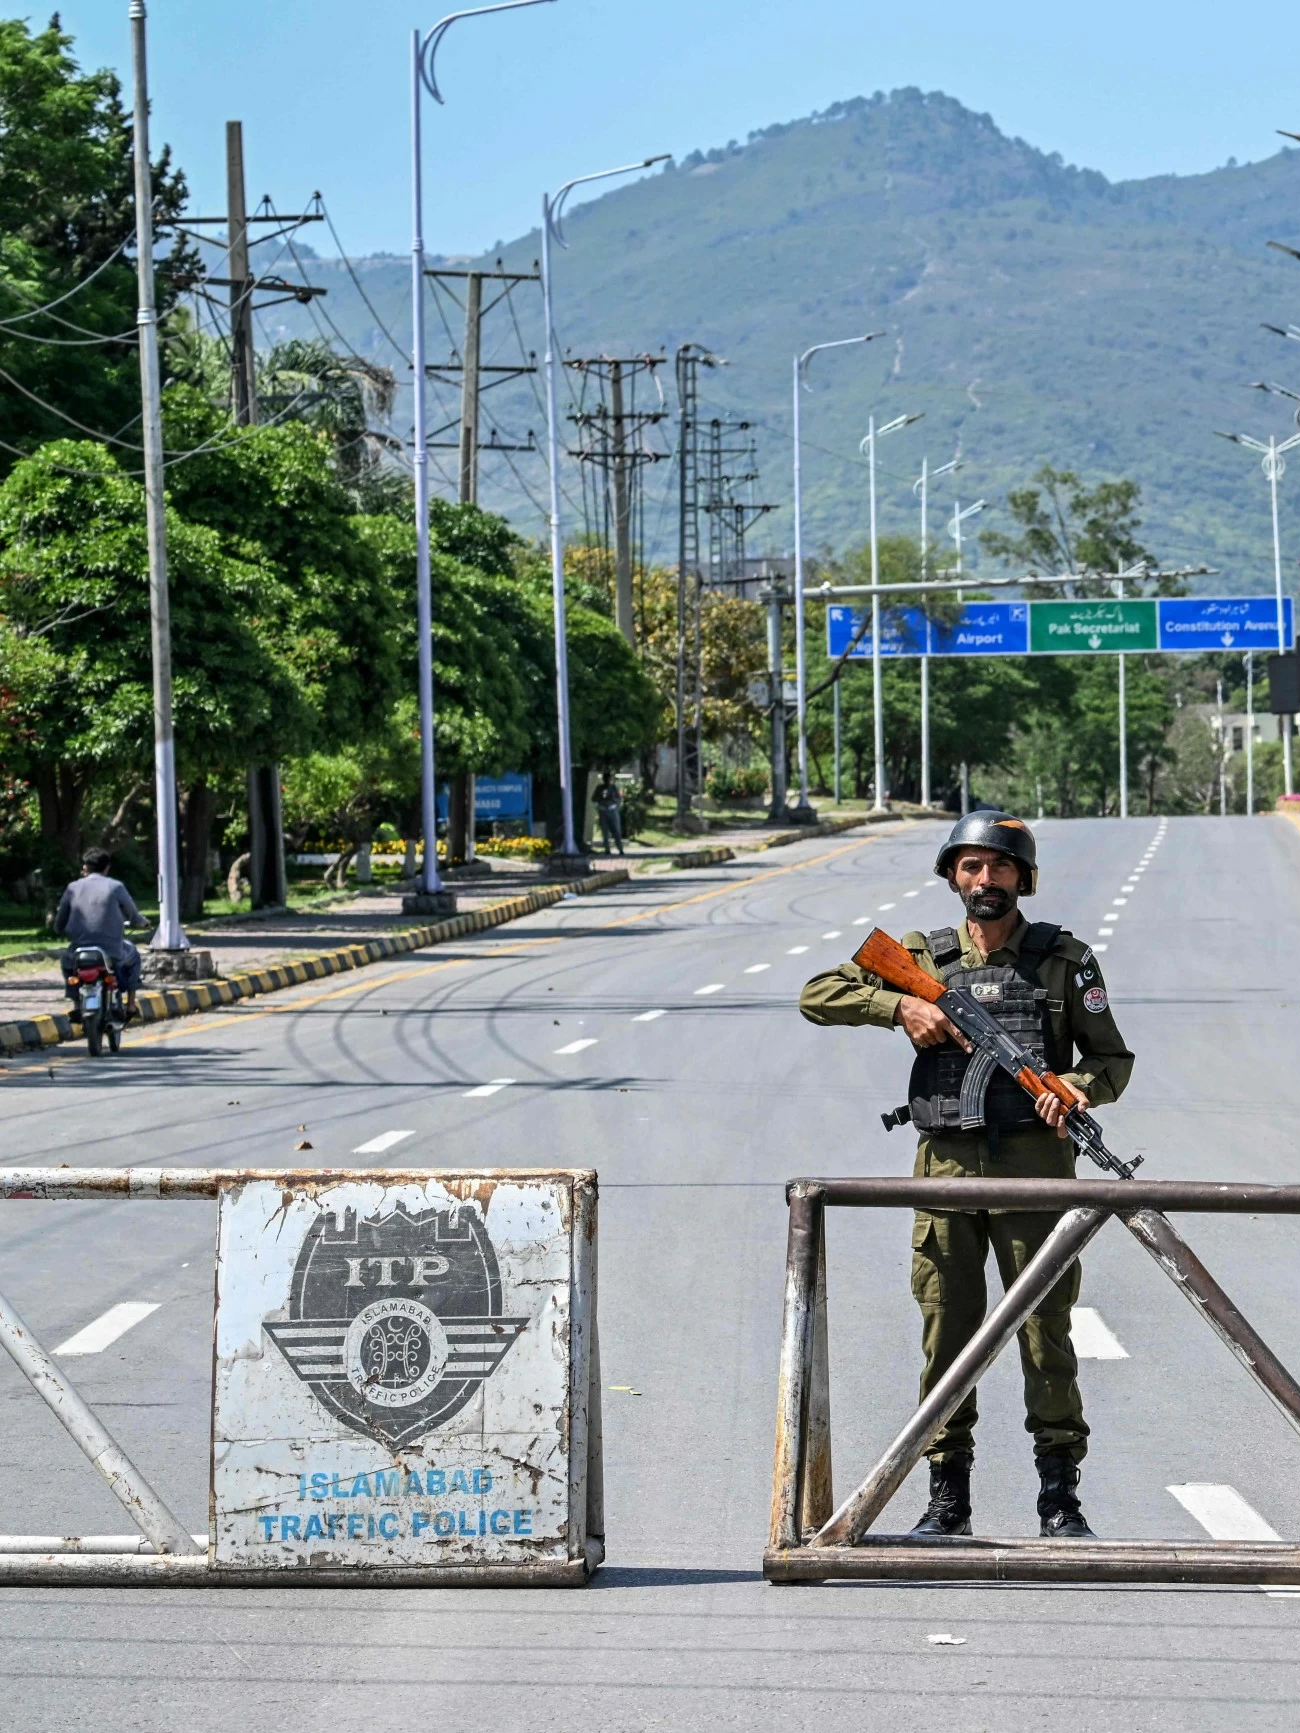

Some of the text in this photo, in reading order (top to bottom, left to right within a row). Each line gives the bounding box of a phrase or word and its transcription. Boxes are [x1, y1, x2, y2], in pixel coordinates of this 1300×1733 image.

[1048, 622, 1140, 635] Pak Secretariat
[1165, 620, 1240, 633] Constitution
[853, 640, 904, 656] igway
[956, 632, 1003, 646] Airport
[344, 1257, 450, 1287] ITP
[362, 1303, 431, 1325] ISLAMABAD
[351, 1365, 440, 1402] TRFFIC POLICE
[299, 1467, 493, 1499] ISLAMABAD
[259, 1510, 533, 1541] TRAFFIC POLICE
